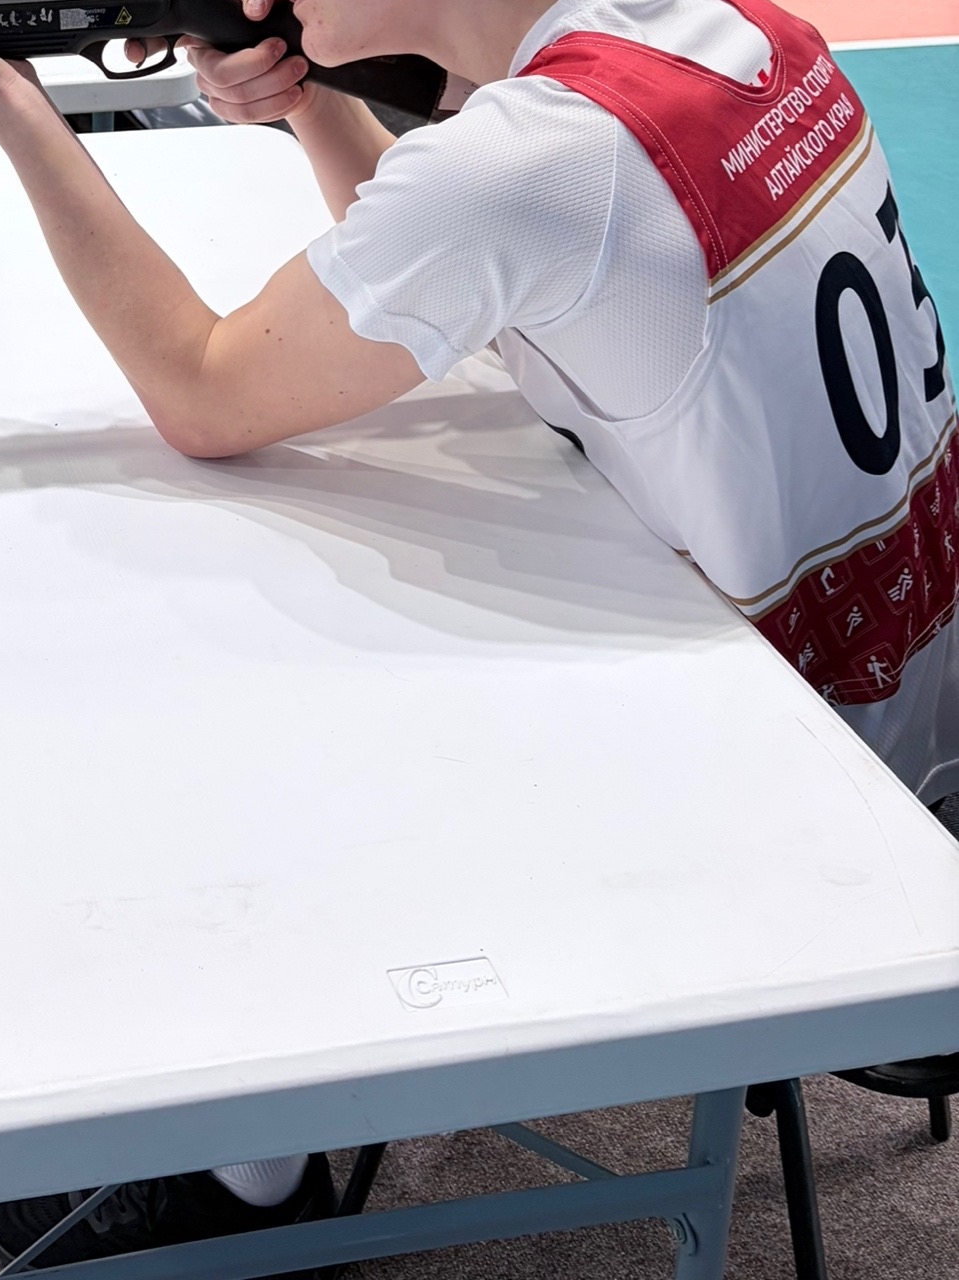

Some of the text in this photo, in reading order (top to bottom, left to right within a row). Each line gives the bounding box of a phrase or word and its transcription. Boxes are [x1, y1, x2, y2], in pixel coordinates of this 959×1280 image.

[720, 53, 836, 182] МИНИСТЕРСТВО СПОРТА
[763, 92, 856, 201] АЛТАЙСКОГО КРАЯ
